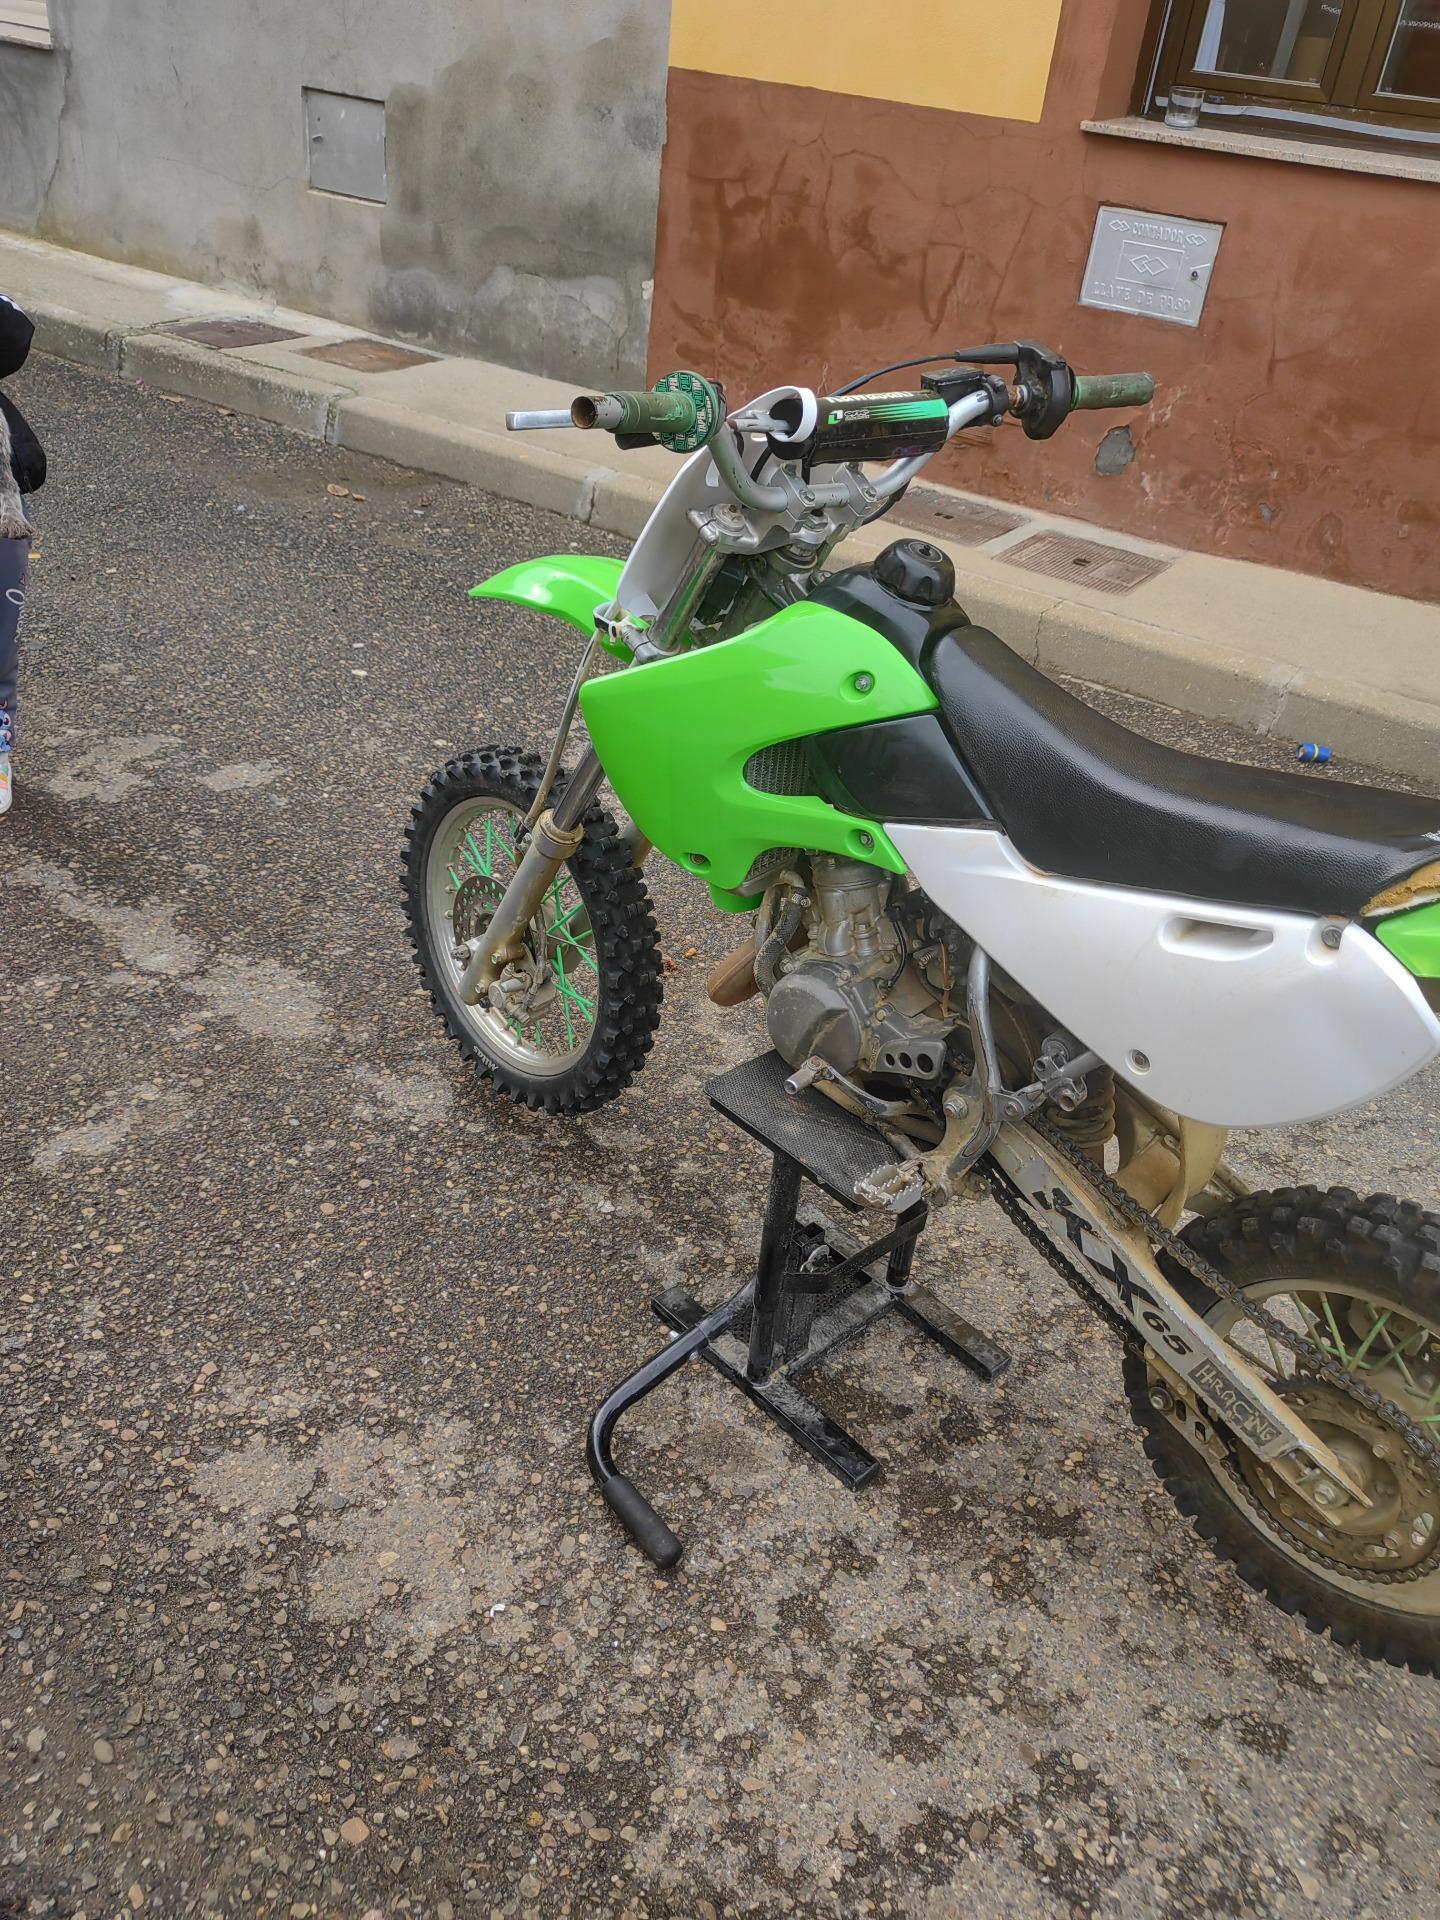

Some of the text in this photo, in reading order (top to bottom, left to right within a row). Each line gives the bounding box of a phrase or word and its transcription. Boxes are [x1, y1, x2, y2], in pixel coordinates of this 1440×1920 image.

[1132, 222, 1184, 244] CONTADOR
[1093, 281, 1191, 313] LLAVE DE PASO
[1032, 1187, 1193, 1356] KX 65
